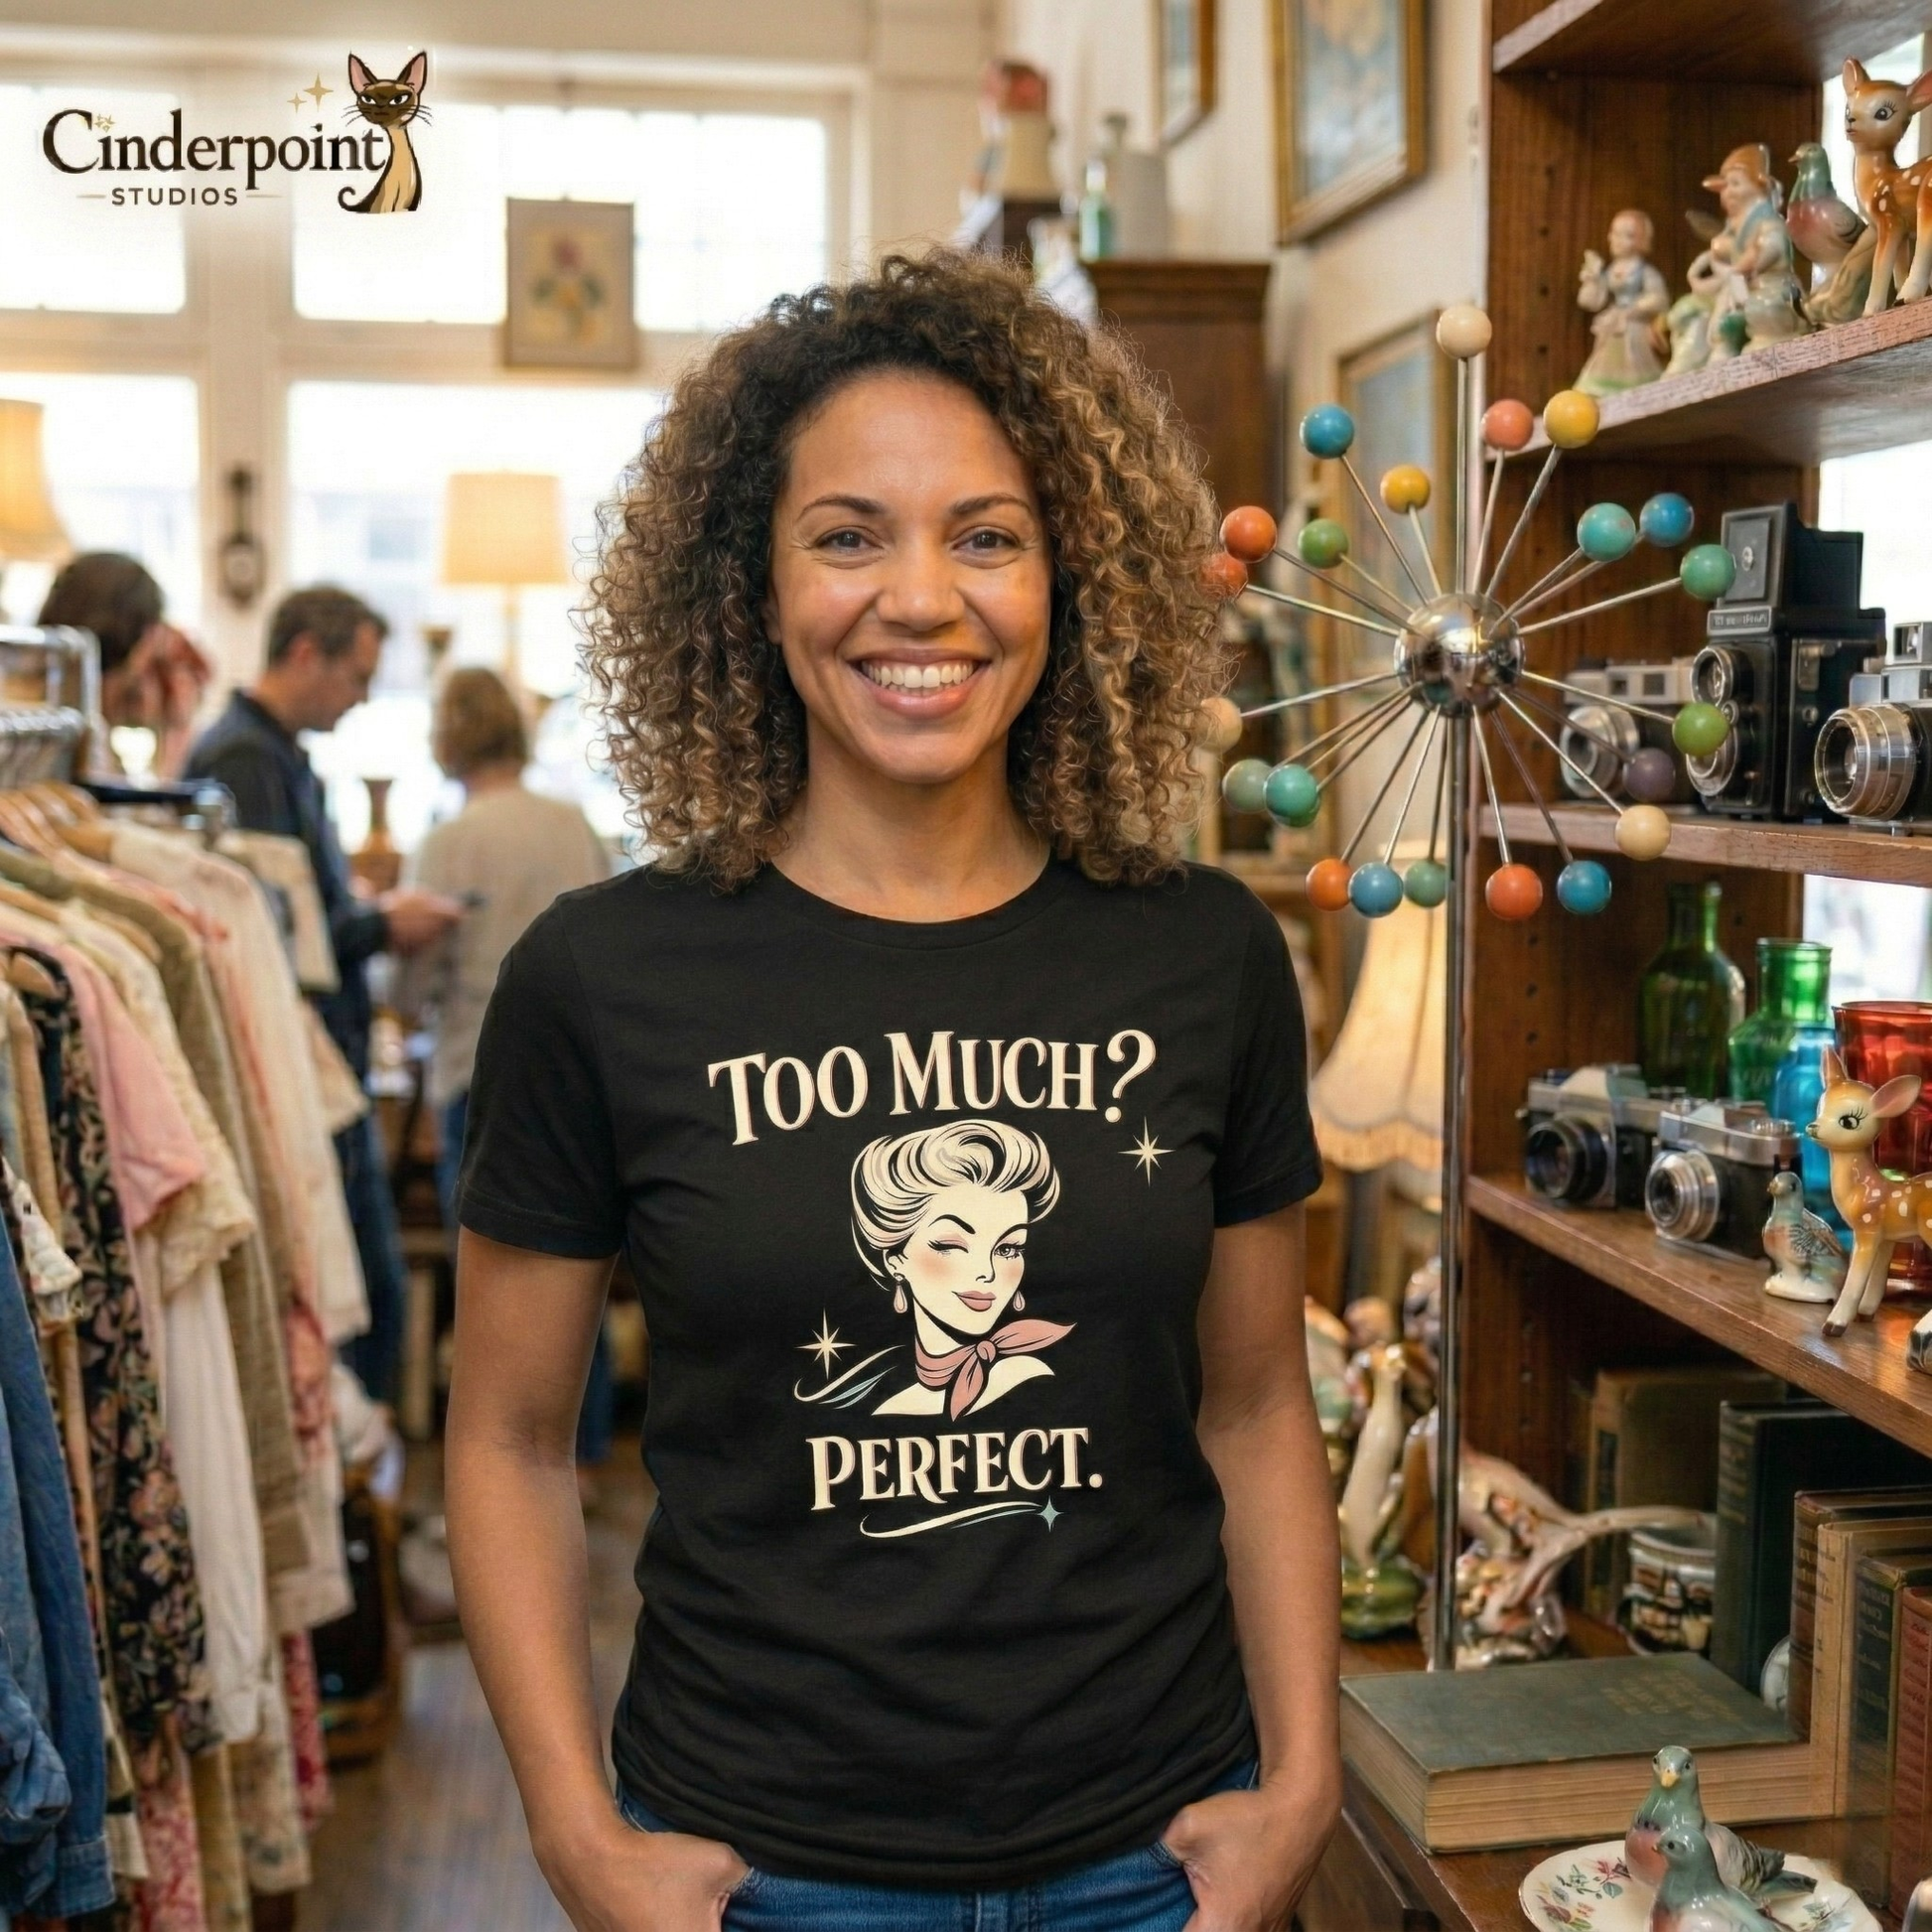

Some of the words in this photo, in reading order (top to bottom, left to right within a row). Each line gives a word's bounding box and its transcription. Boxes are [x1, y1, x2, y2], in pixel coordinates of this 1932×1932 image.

[707, 1045, 869, 1146] TOO
[884, 1029, 1157, 1123] MUCH?
[805, 1427, 1103, 1511] PERFECT.
